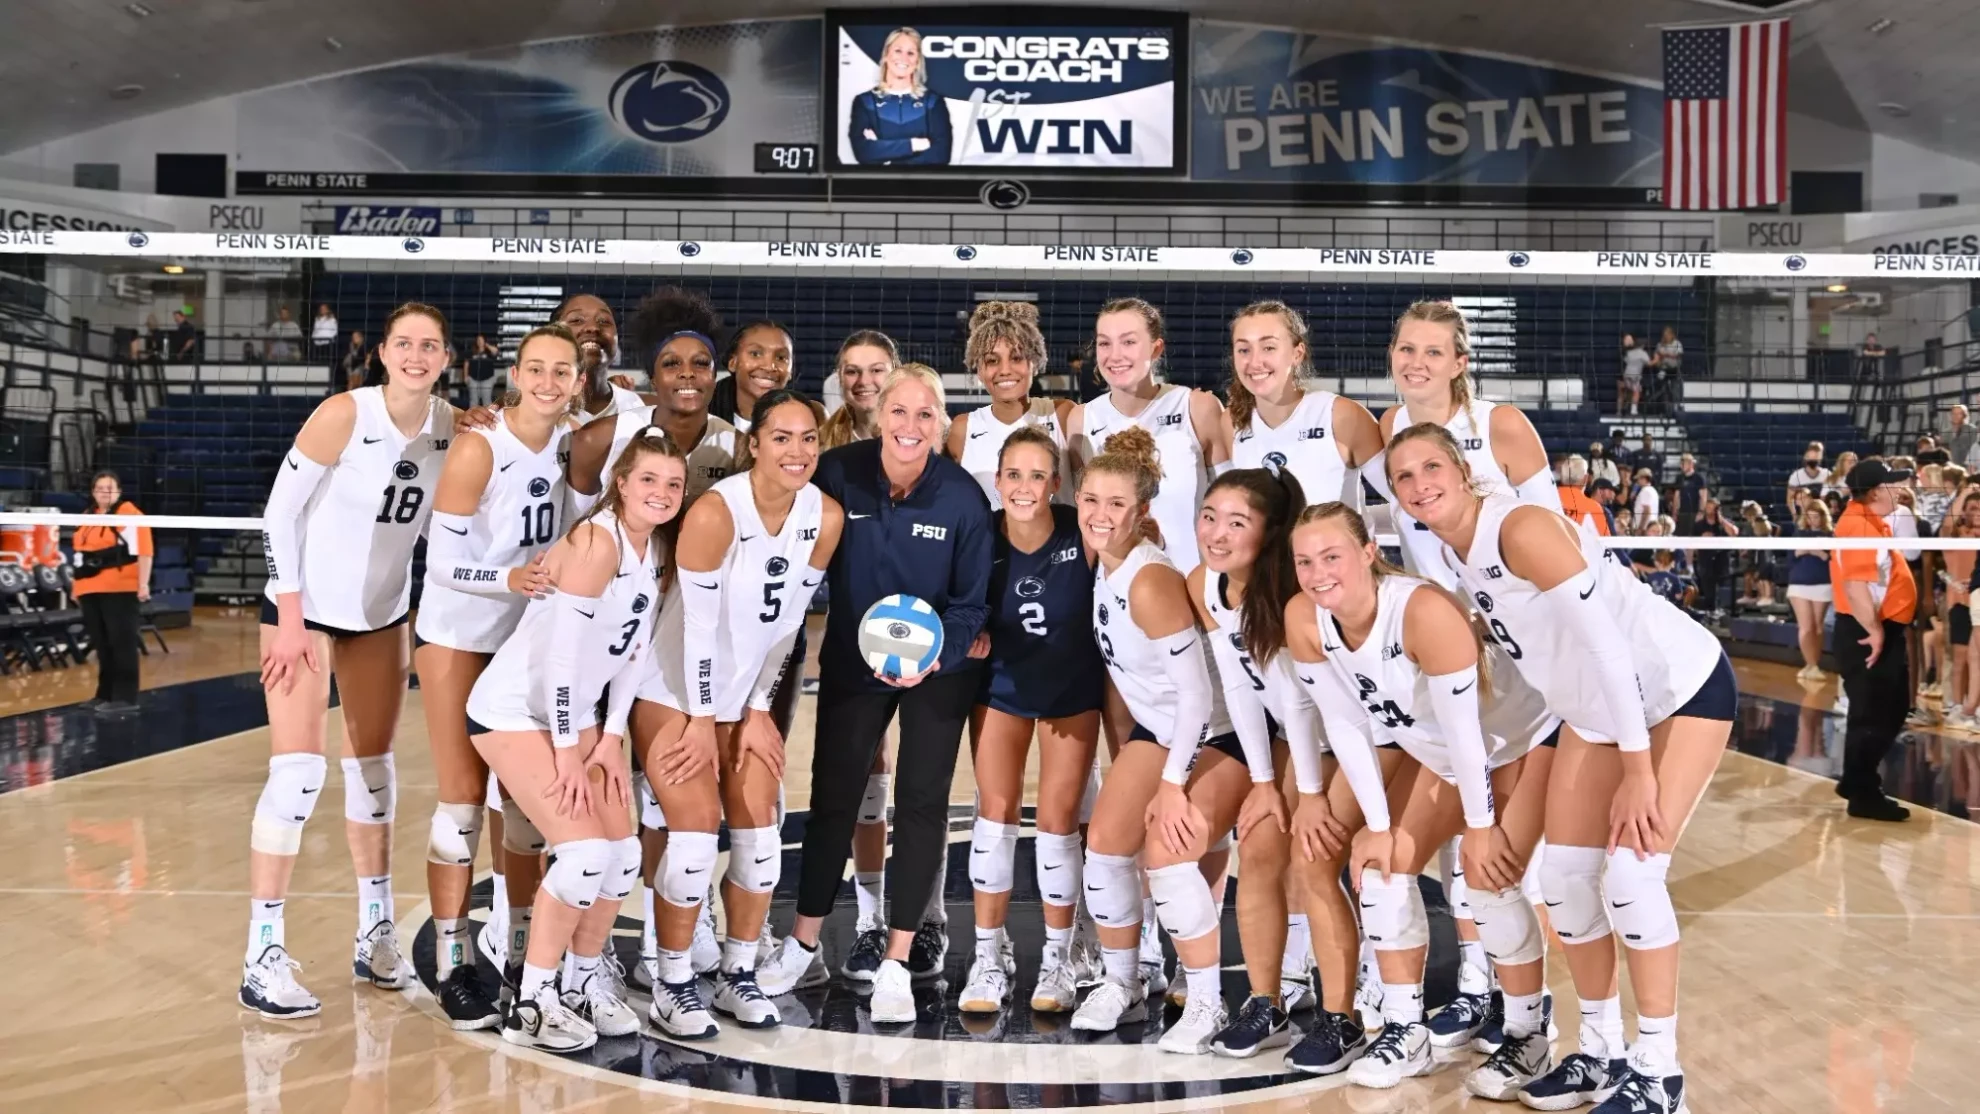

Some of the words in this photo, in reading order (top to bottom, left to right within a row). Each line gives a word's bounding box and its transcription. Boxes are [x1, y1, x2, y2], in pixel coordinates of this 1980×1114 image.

[921, 35, 1170, 60] CONGRATS
[964, 59, 1123, 83] COACH
[1200, 86, 1257, 117] WE
[1268, 79, 1340, 111] ARE
[977, 118, 1132, 155] WIN
[1225, 106, 1405, 171] PENN
[1426, 91, 1632, 156] STATE
[771, 146, 814, 168] 9:07
[265, 173, 311, 188] PENN
[316, 174, 367, 188] STATE
[210, 204, 264, 231] PSECU
[216, 233, 267, 250] PENN
[273, 234, 330, 250] STATE
[491, 238, 543, 254] PENN
[549, 239, 606, 255] STATE
[1748, 222, 1802, 247] PSECU
[768, 241, 820, 258] PENN
[826, 242, 882, 258] STATE
[1043, 246, 1095, 262] PENN
[1101, 246, 1158, 263] STATE
[1320, 249, 1372, 265] PENN
[1378, 249, 1435, 266] STATE
[1596, 252, 1648, 268] PENN
[1655, 252, 1711, 269] STATE
[1874, 254, 1926, 271] PENN
[376, 485, 424, 524] 18
[519, 501, 554, 547] 10
[912, 523, 947, 541] PSU
[453, 566, 469, 581] WE
[472, 569, 498, 582] ARE
[759, 581, 785, 623] 5
[1018, 602, 1048, 636] 2
[608, 618, 641, 657] 3
[699, 658, 712, 679] WE
[556, 686, 570, 707] WE
[699, 680, 712, 705] ARE
[557, 710, 570, 735] ARE
